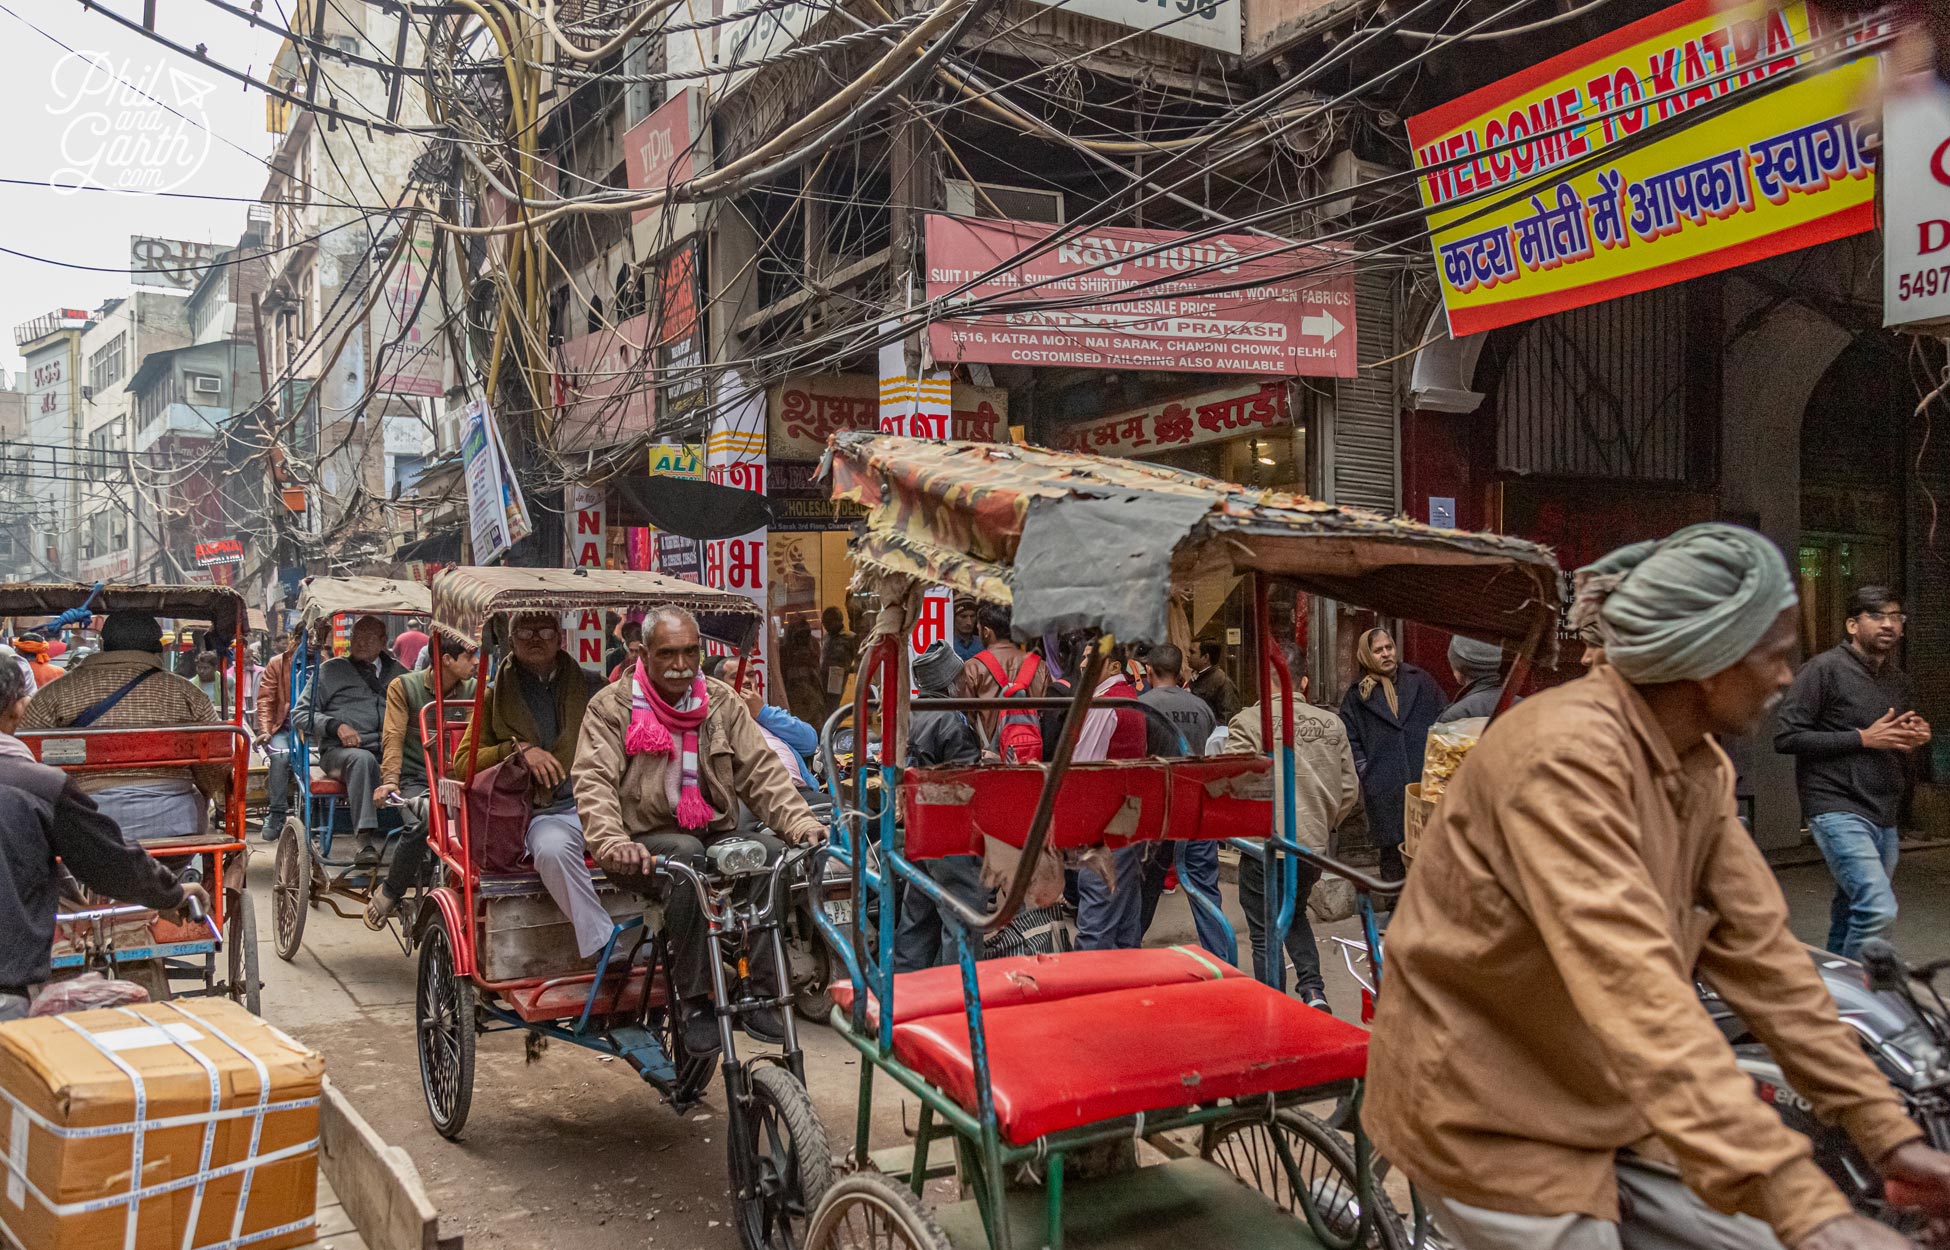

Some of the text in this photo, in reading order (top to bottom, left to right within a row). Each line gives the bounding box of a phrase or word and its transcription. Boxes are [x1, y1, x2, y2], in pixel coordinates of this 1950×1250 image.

[1419, 88, 1588, 204] WELCOME
[1587, 67, 1643, 144] TO
[1648, 8, 1797, 120] KATRA
[1440, 226, 1514, 286] कटरा
[1514, 183, 1588, 264] मोती
[1588, 169, 1623, 242] में
[1627, 148, 1748, 234] आपका
[931, 268, 962, 284] SUIT
[1024, 274, 1076, 291] SUITING
[1246, 287, 1298, 303] WOOLEN
[1302, 291, 1351, 306] FABRICS
[1101, 300, 1177, 315] WHOLESALE
[1180, 302, 1217, 317] PRICE
[1012, 313, 1074, 326] SANT
[1132, 319, 1169, 332] OM
[1178, 323, 1284, 338] PRAKASH
[382, 343, 439, 357] ASHION
[991, 333, 1037, 345] KATRA
[1046, 335, 1081, 348] MOTI,
[1086, 337, 1109, 348] NAI
[1113, 338, 1162, 351] SARAK,
[1167, 340, 1227, 353] CHANDNI
[1231, 343, 1285, 357] CHOWK,
[1288, 346, 1337, 358] DELHI-6
[1011, 350, 1285, 371] COSTOMISED TAILORING ALSO AVAILABLE
[653, 455, 697, 472] ALI
